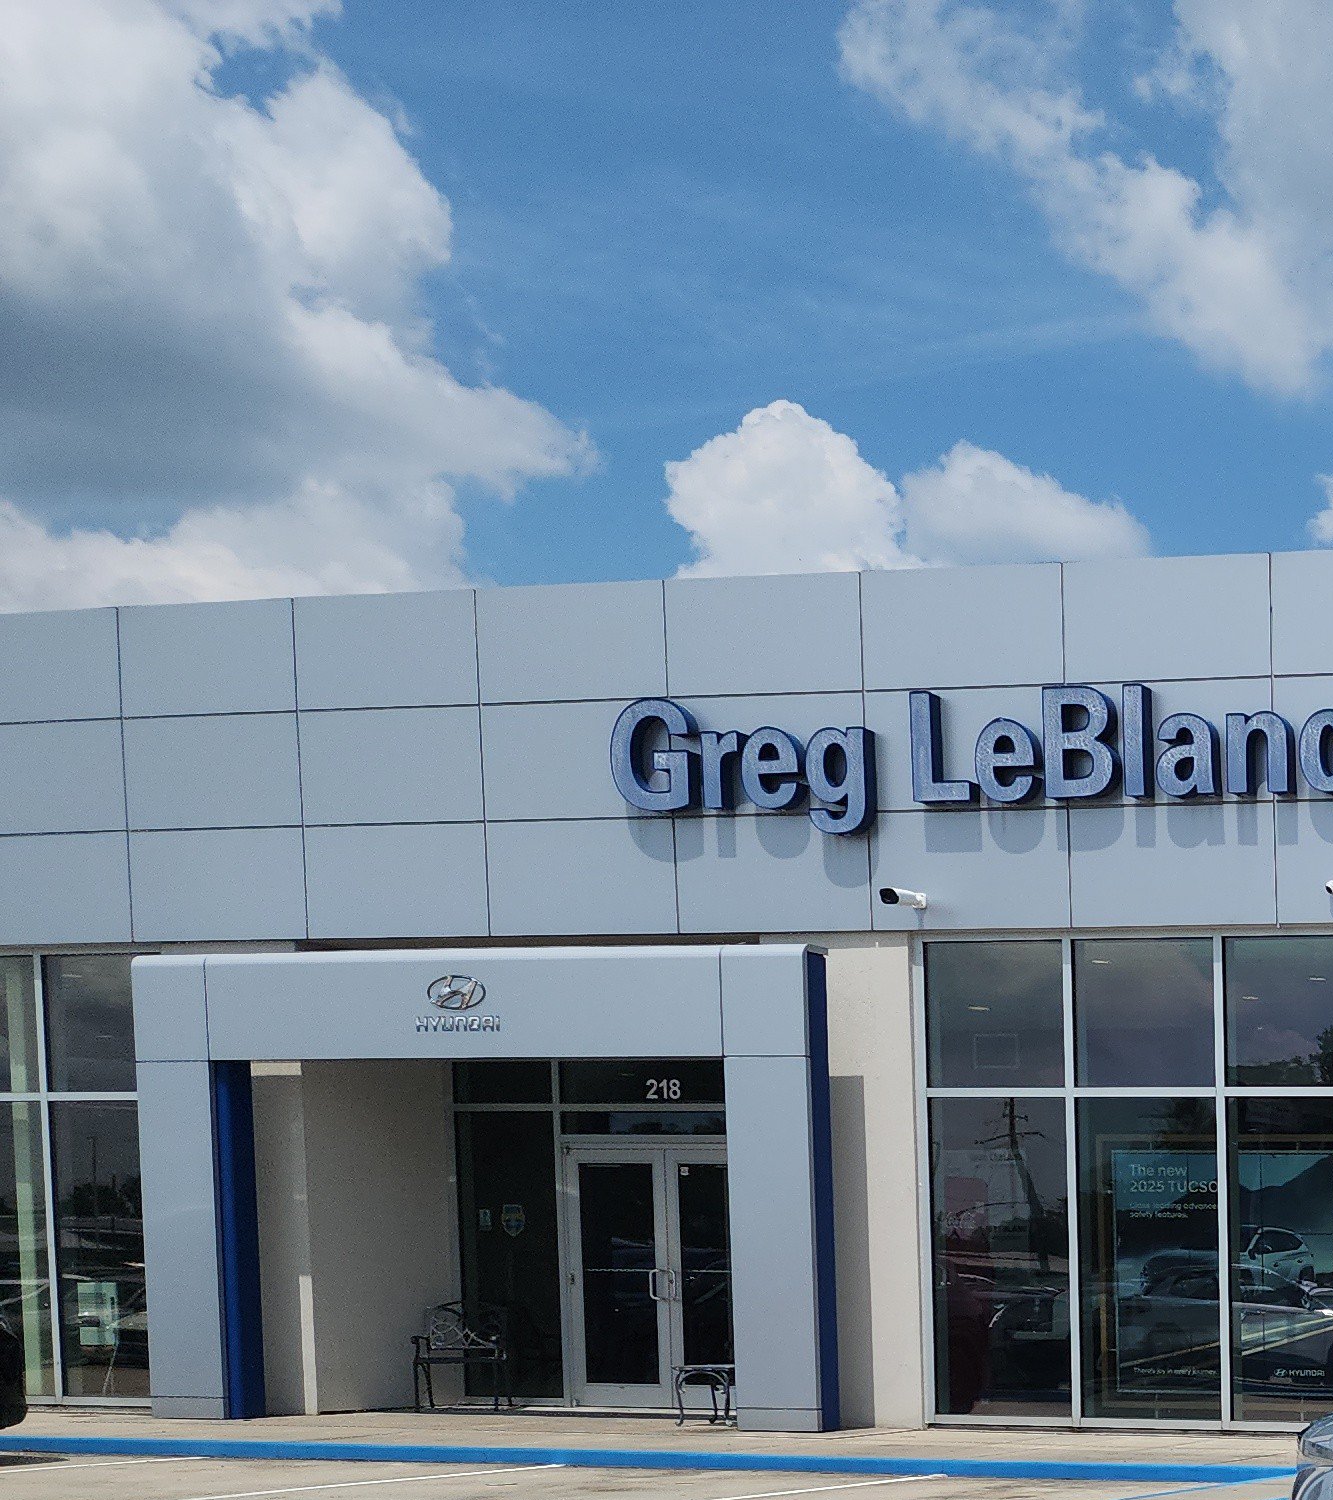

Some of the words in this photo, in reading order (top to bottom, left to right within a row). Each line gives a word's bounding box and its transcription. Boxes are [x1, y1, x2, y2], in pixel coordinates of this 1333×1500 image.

[610, 697, 878, 836] Greg
[415, 1014, 501, 1033] HYUNDAI
[645, 1078, 681, 1100] 218
[1129, 1163, 1155, 1177] The
[1157, 1165, 1188, 1177] new
[1129, 1179, 1166, 1193] 2025
[1167, 1179, 1218, 1193] TUCSO
[1183, 1202, 1217, 1210] advance
[1288, 1369, 1326, 1377] HYUNDAI
